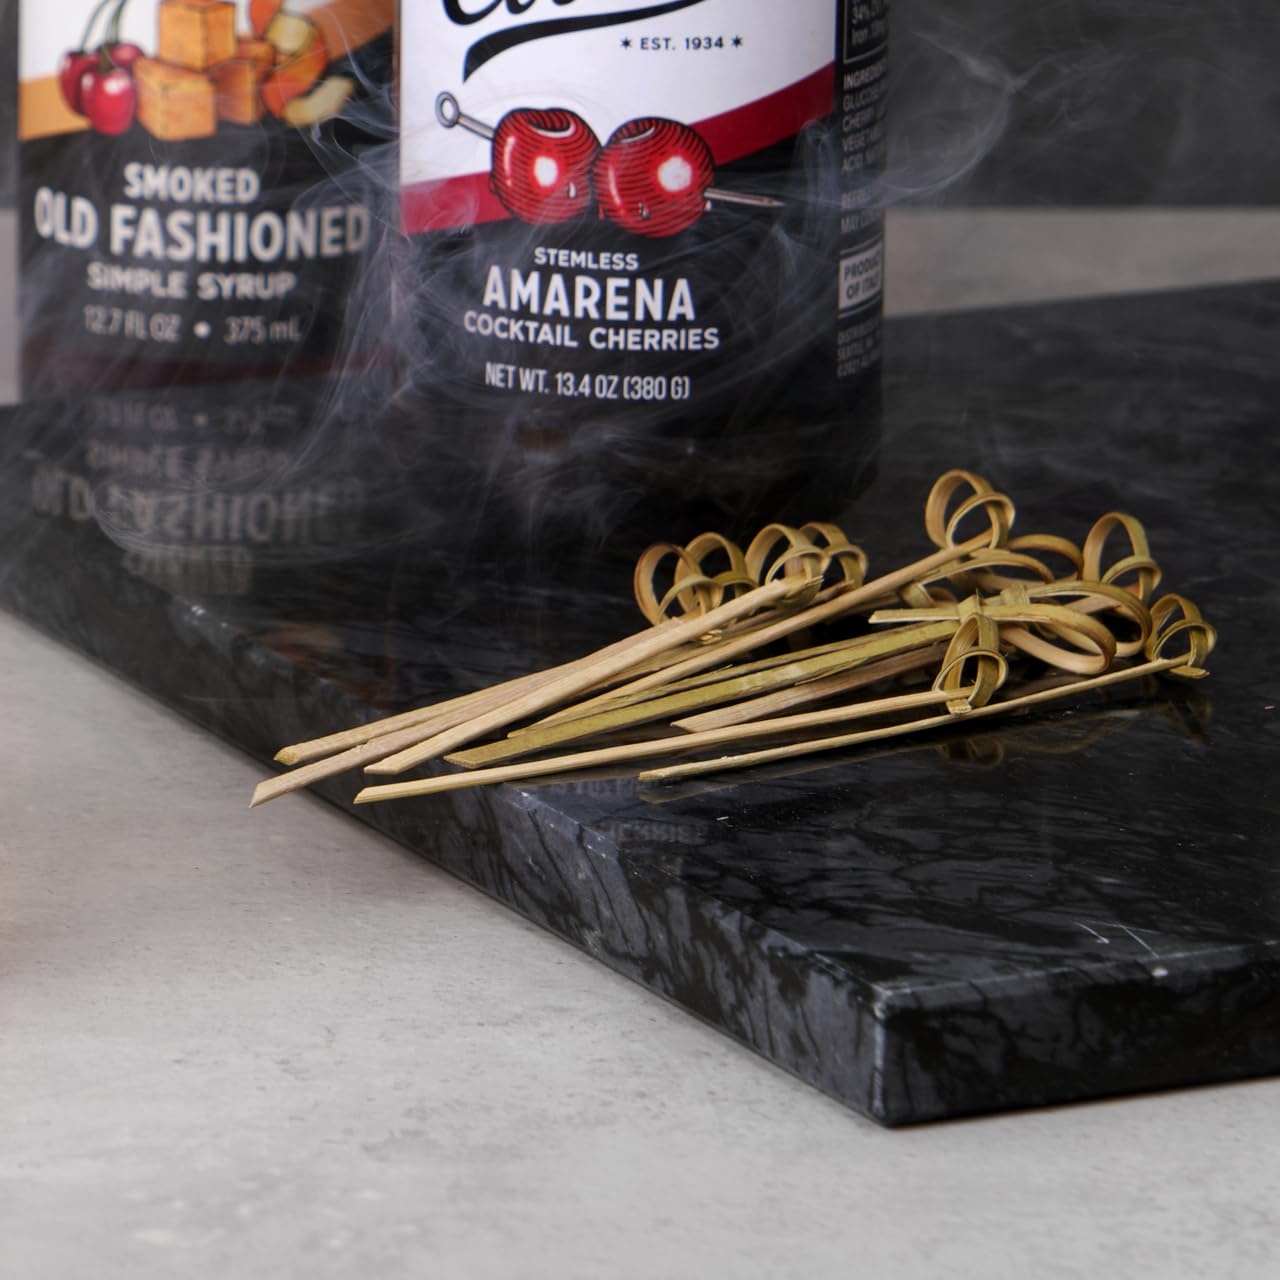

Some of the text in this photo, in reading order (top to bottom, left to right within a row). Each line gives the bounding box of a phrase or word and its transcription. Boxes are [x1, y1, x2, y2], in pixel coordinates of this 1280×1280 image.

[639, 34, 725, 52] EST. 1934
[123, 162, 260, 204] SMOKED
[34, 186, 371, 263] OLD FASHIONED
[534, 247, 639, 272] STEMLESS
[87, 261, 298, 301] SIMPLE SYRUP
[482, 265, 696, 322] AMARENA
[150, 312, 182, 343] OZ
[223, 316, 266, 345] 375
[463, 311, 720, 352] COCKTAIL CHERRIES
[485, 361, 516, 389] NET
[519, 368, 549, 394] WT.
[555, 372, 591, 398] 13.4
[595, 374, 619, 399] OZ
